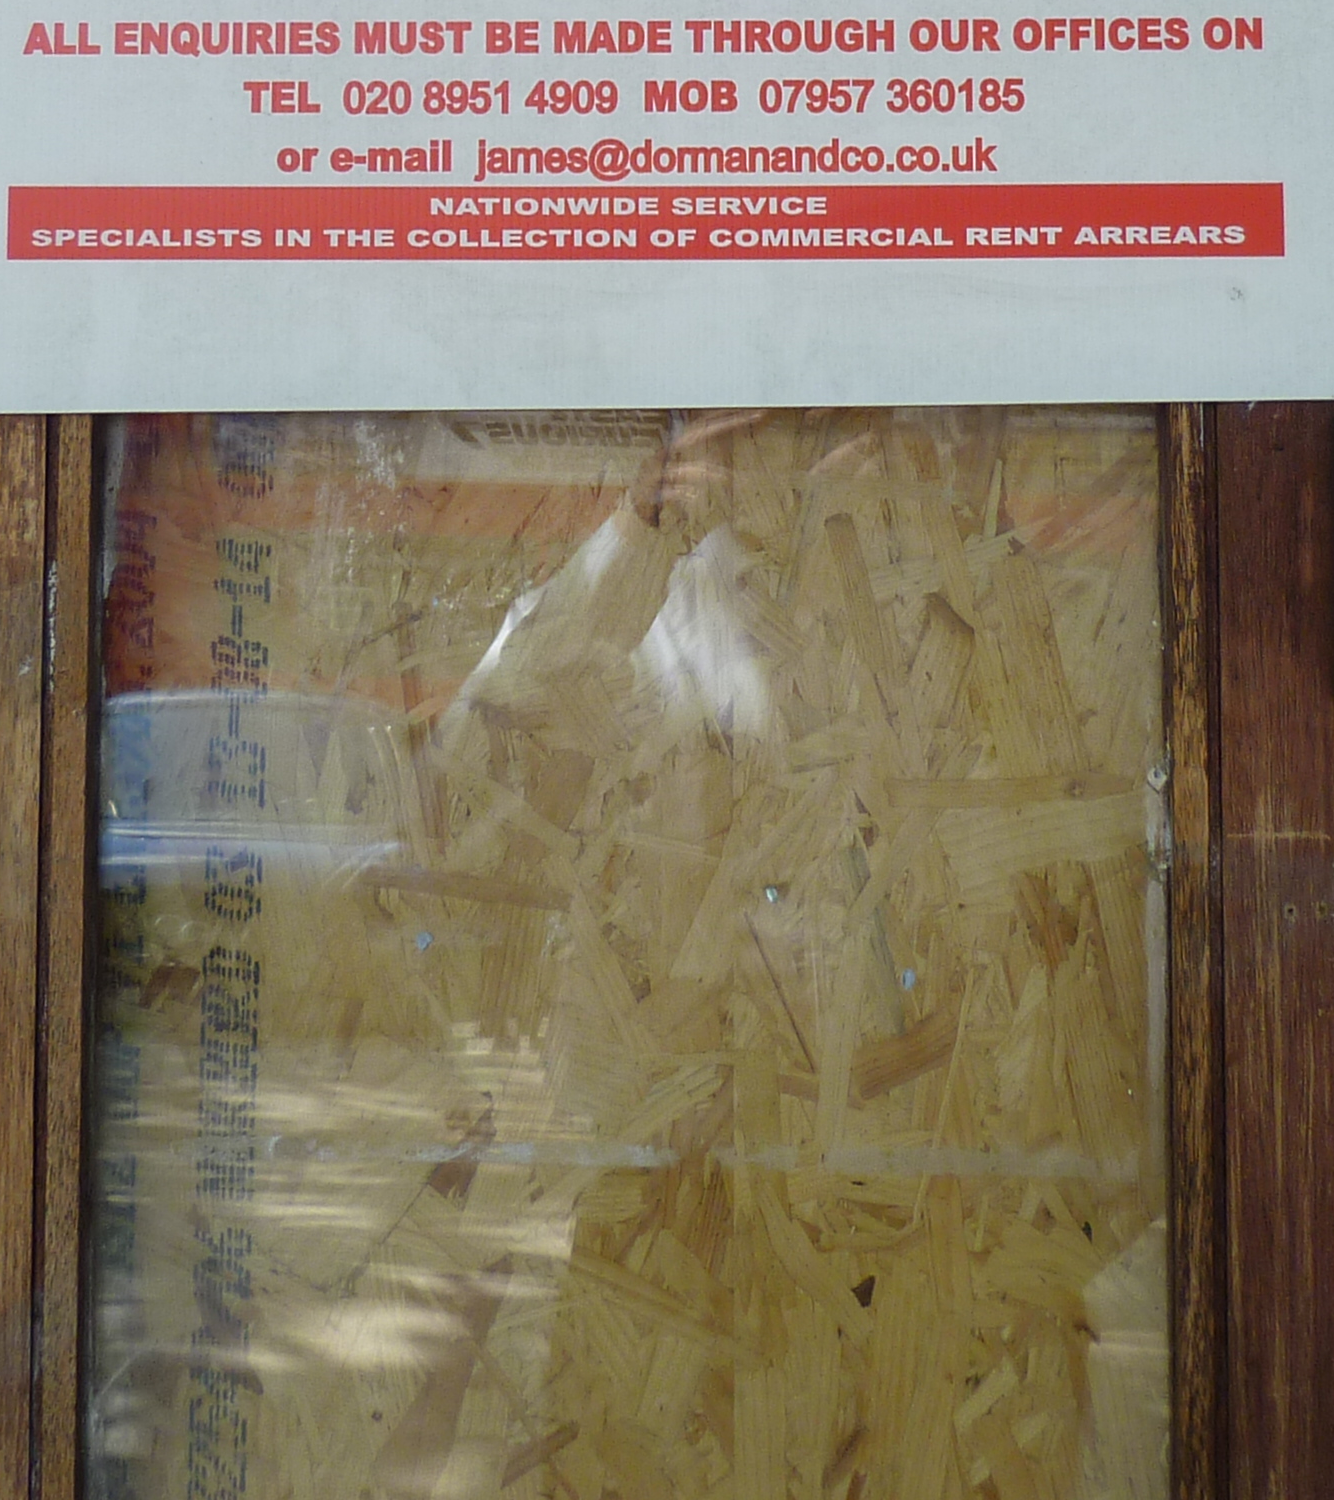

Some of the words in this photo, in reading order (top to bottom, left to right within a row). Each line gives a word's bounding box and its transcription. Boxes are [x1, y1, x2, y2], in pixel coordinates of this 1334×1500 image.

[25, 24, 99, 54] ALL
[116, 23, 339, 55] ENQUIRIES
[356, 22, 471, 53] MUST
[487, 22, 538, 53] BE
[556, 22, 671, 52] MADE
[686, 20, 894, 52] THROUGH
[911, 20, 999, 51] OUR
[1014, 18, 1189, 50] OFFICES
[1205, 18, 1262, 49] ON
[245, 82, 320, 112] TEL
[345, 82, 411, 113] 020
[425, 81, 509, 113] 8951
[526, 81, 617, 113] 4909
[646, 81, 737, 112] MOB
[761, 80, 874, 112] 07957
[888, 79, 1025, 112] 360185
[278, 149, 317, 171] or
[332, 140, 451, 171] e-mail
[476, 138, 996, 181] james@dormanandco.co.uk
[431, 197, 658, 215] NATIONWIDE
[673, 197, 826, 215] SERVICE
[33, 229, 262, 247] SPECIALISTS
[276, 229, 311, 247] IN
[324, 229, 394, 247] THE
[408, 229, 637, 247] COLLECTION
[651, 229, 696, 247] OF
[710, 228, 953, 247] COMMERCIAL
[967, 227, 1062, 245] RENT
[1075, 226, 1245, 244] ARREARS
